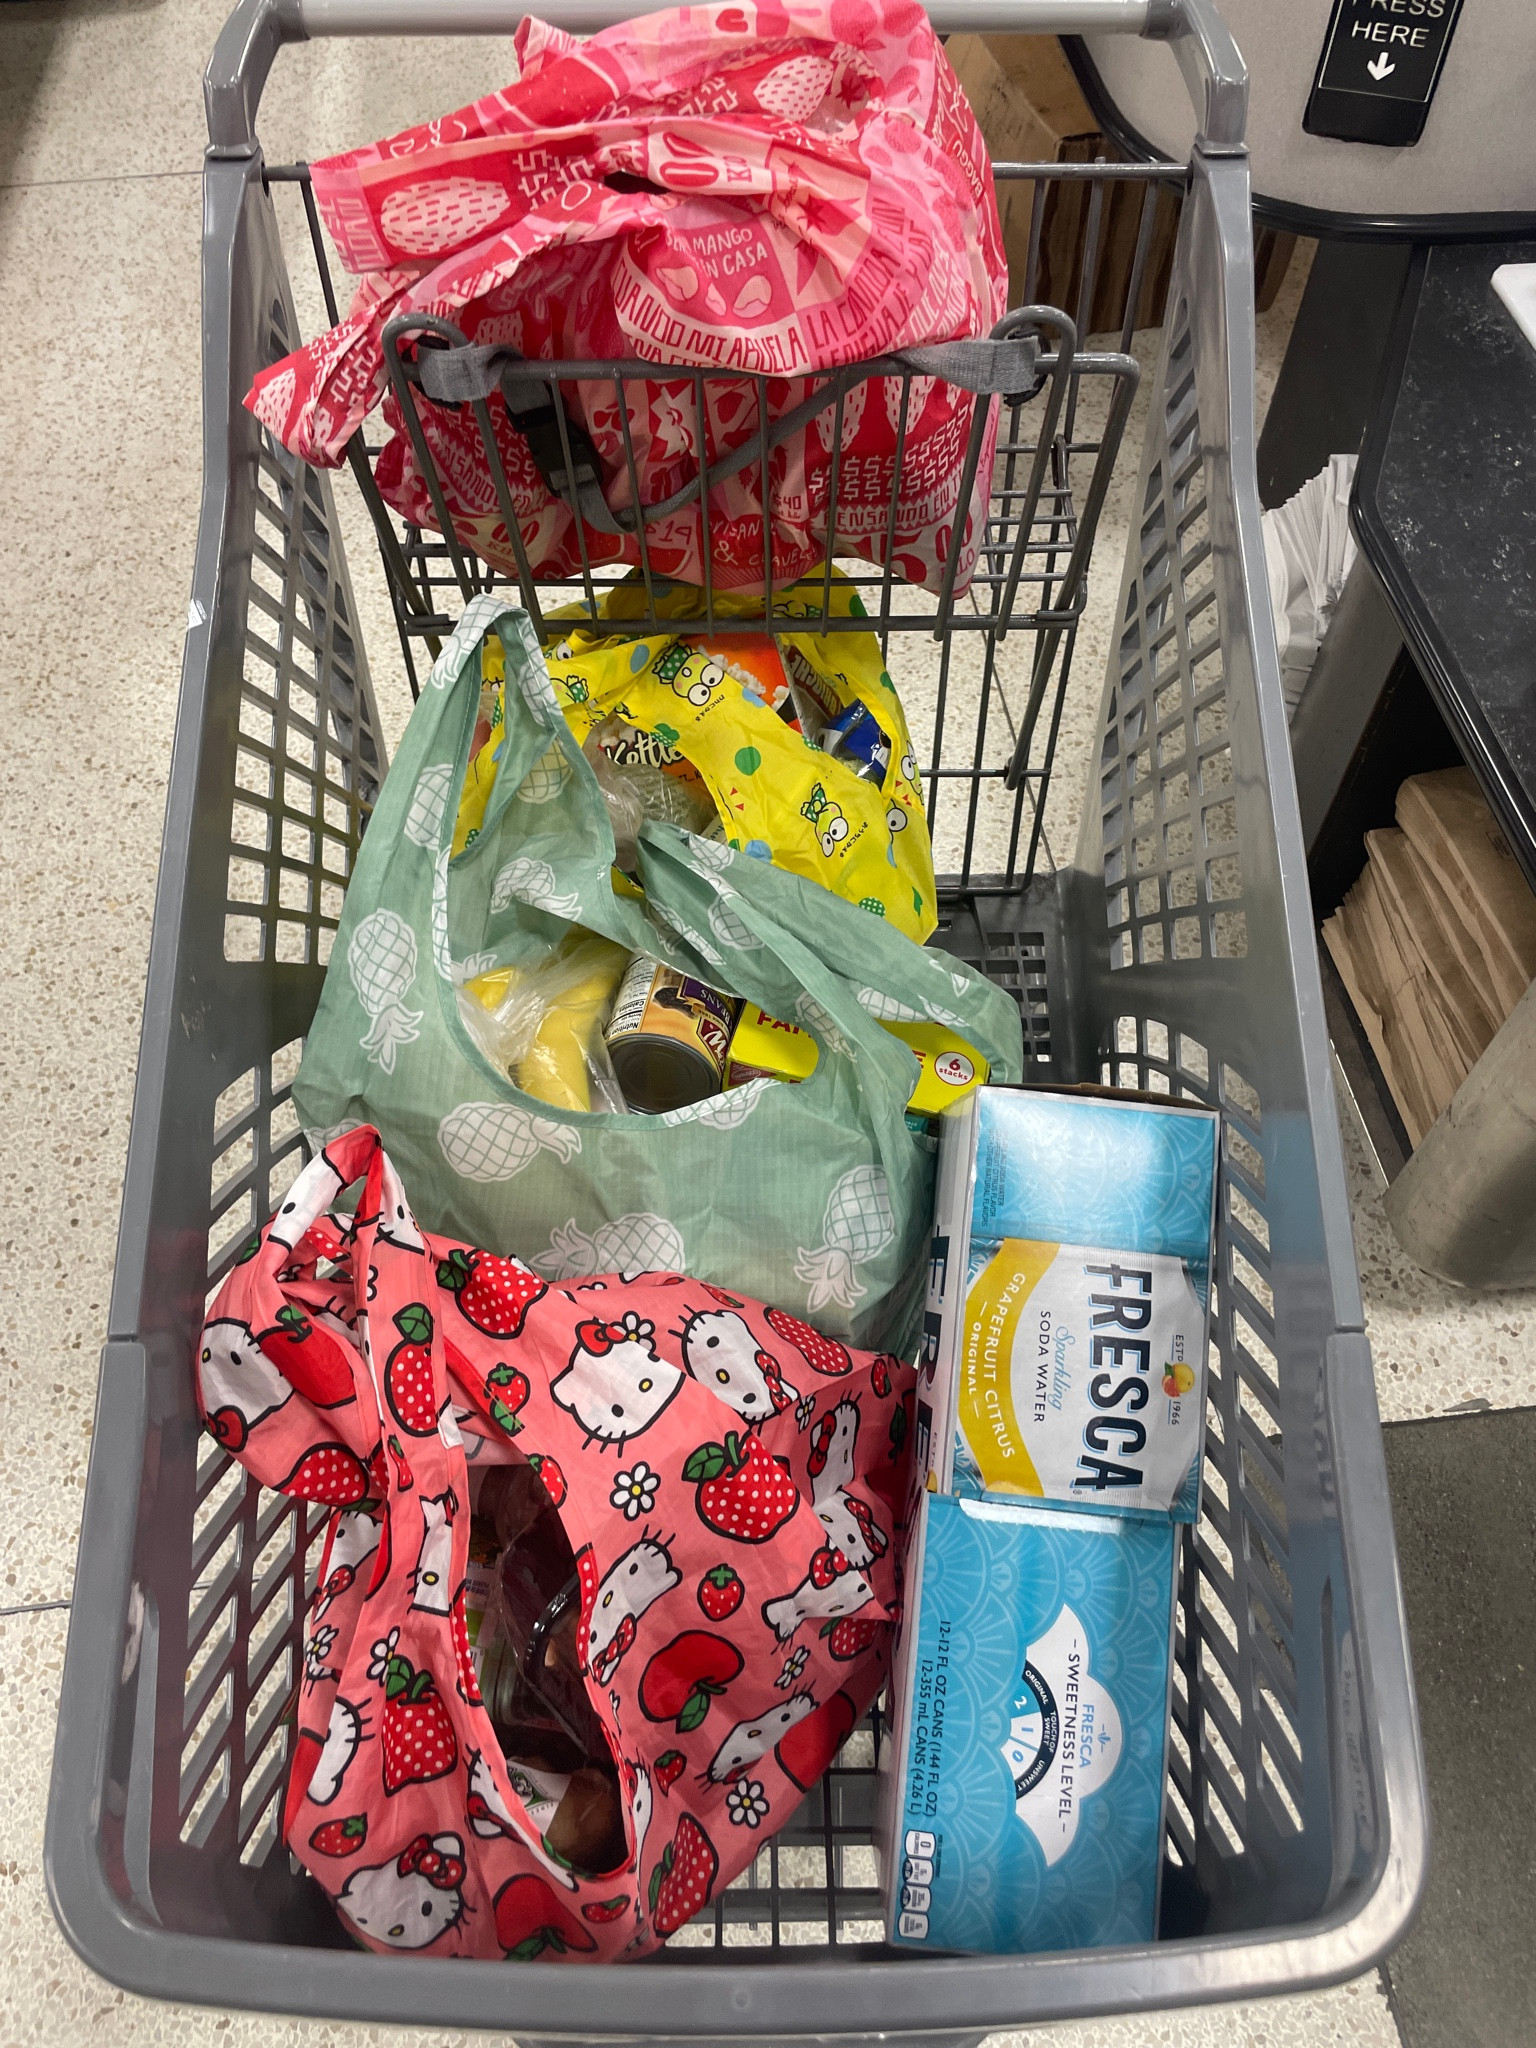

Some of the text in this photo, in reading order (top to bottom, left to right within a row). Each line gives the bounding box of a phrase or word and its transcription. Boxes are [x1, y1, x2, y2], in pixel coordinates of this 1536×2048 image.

[1352, 20, 1430, 48] HERE
[953, 139, 984, 198] BAGGU
[692, 228, 753, 256] MANGO
[722, 241, 768, 276] CASA
[806, 309, 839, 350] LA
[685, 329, 727, 362] MI
[726, 326, 808, 374] ABUELA
[700, 988, 732, 1025] BEANS
[938, 1067, 968, 1080] stacks
[948, 1059, 961, 1071] 6
[981, 1198, 990, 1227] FLAVORS
[989, 1193, 998, 1217] FLAVOR
[997, 1184, 1006, 1206] WATER
[967, 1321, 982, 1396] ORIGINAL
[983, 1272, 1026, 1459] GRAPEFRUIT CITRUS
[1033, 1310, 1051, 1423] SODA WATER
[1048, 1325, 1076, 1411] Sparkling
[1071, 1262, 1153, 1493] FRESCA
[1171, 1400, 1181, 1425] 1966
[1014, 1695, 1028, 1709] 2
[1025, 1669, 1049, 1705] ORIGINAL
[922, 1620, 951, 1818] 12-12 FL OZ CANS (144 FL OZ)
[1043, 1717, 1051, 1745] SWEET
[1058, 1653, 1080, 1819] SWEETNESS LEVEL
[1079, 1703, 1095, 1769] FRESCA
[907, 1659, 933, 1816] 12-355 mL CANS (4.26 L)
[1049, 1740, 1056, 1753] OF
[1017, 1759, 1046, 1791] UNSWEET
